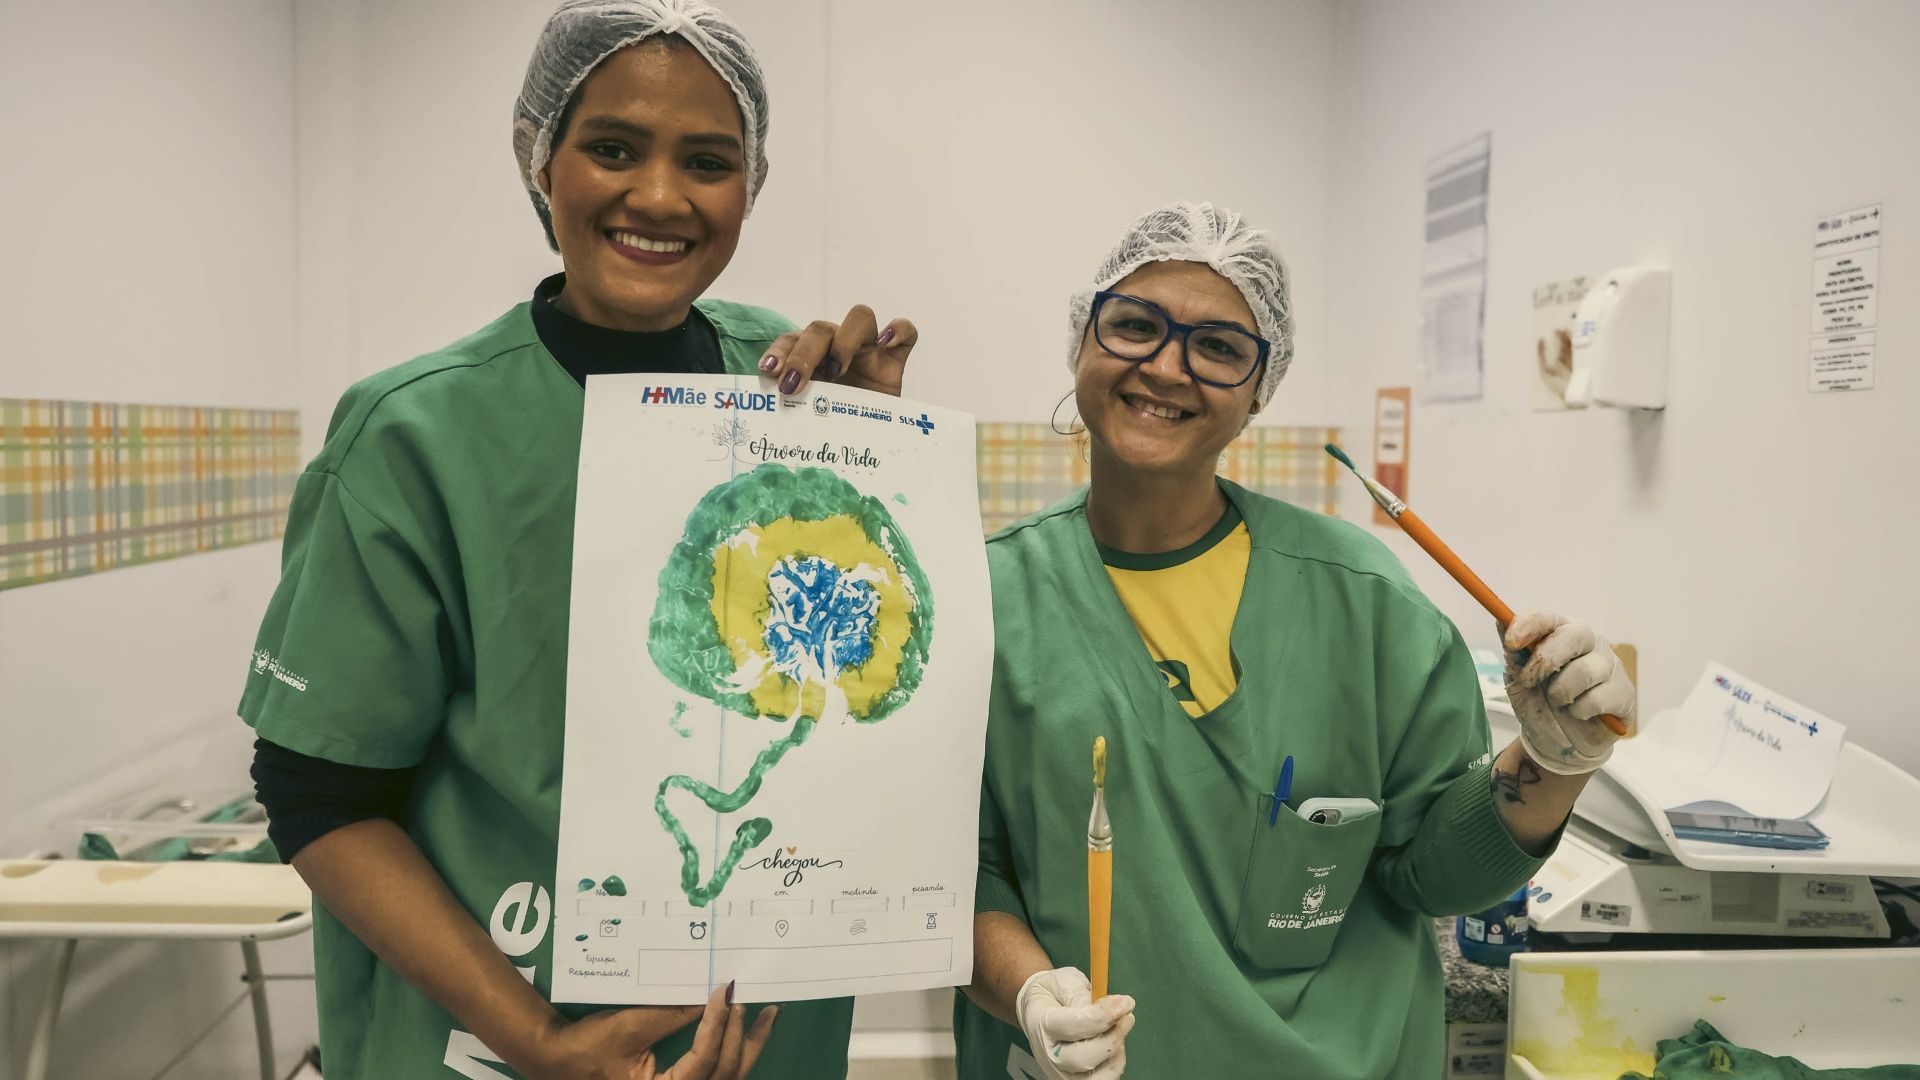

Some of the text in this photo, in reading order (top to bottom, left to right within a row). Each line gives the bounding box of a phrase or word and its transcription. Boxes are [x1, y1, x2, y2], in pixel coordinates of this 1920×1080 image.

[714, 389, 776, 412] SAÚDE
[832, 401, 859, 409] GOVERNO
[871, 407, 892, 415] ESTADO
[832, 406, 892, 422] RIO DE JANEIRO
[900, 415, 915, 426] SUS
[750, 433, 880, 468] Árvore da Vida
[739, 848, 843, 887] chegou
[1267, 913, 1346, 930] RIO DE JANEIRO
[1270, 912, 1306, 921] GOVERNO
